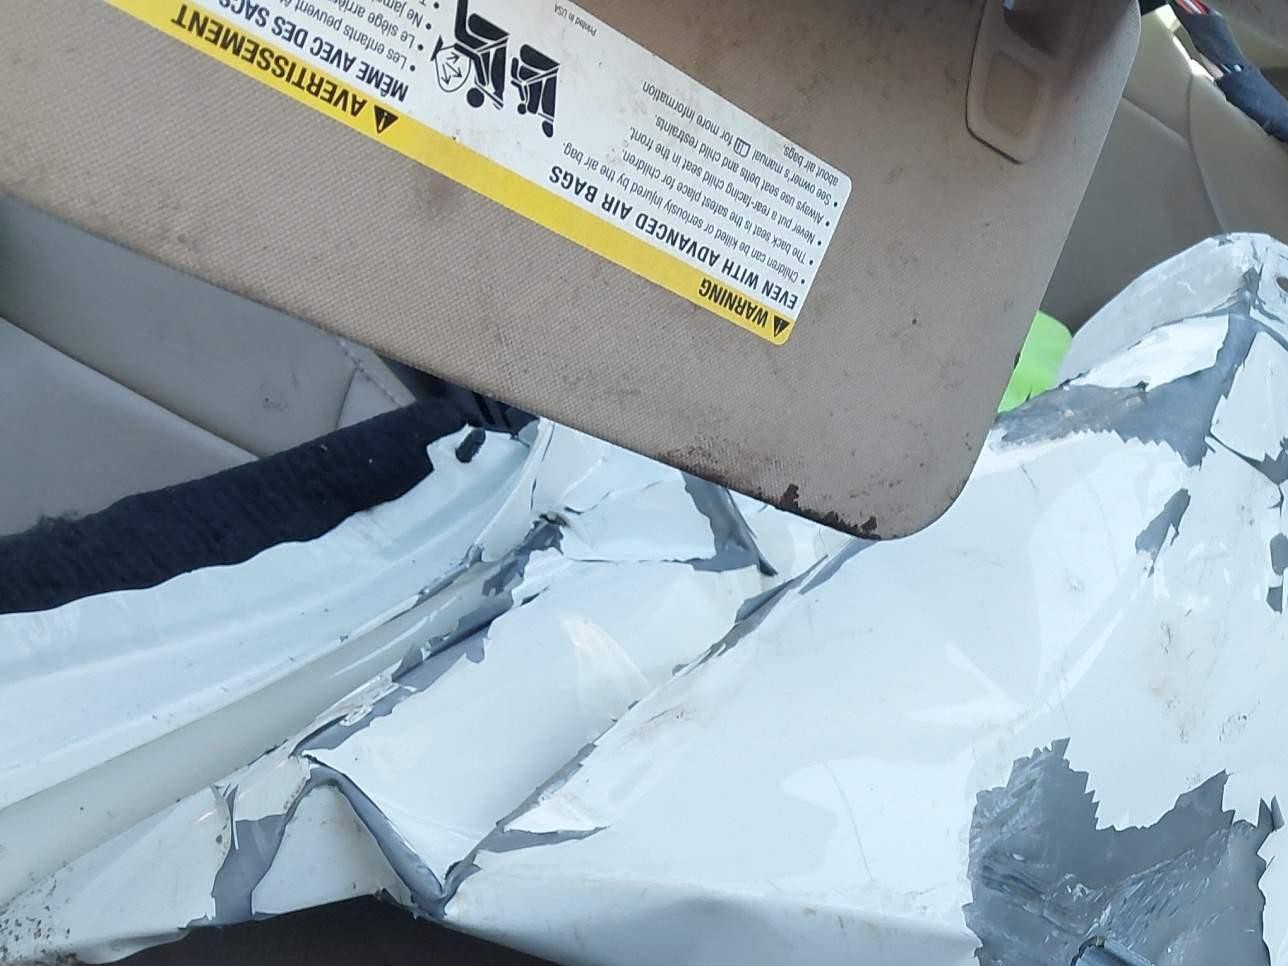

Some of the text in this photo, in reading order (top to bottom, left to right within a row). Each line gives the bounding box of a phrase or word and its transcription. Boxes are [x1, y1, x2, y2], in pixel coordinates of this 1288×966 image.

[271, 15, 309, 49] DES
[294, 0, 407, 70] Les enfants peuvent
[367, 12, 399, 37] siège
[399, 30, 415, 49] Le
[406, 8, 423, 28] Ne
[554, 3, 597, 37] Printed in USA
[170, 4, 368, 117] AVERTISSEMENT
[309, 36, 357, 72] AVEC
[355, 60, 409, 102] MÊME
[642, 81, 832, 206] See owner's manual for more information
[654, 114, 824, 224] Always use seat belts and child restraints.
[783, 143, 839, 186] about air bags.
[622, 148, 806, 265] The back seat is the safest place for children.
[630, 126, 816, 245] Never put a rear-facing child seat in the front.
[548, 165, 798, 310] EVEN WITH ADVANCED AIR BAGS
[562, 142, 799, 283] Children can be killed or seriously injured by the air bag.
[698, 277, 768, 328] WARNING
